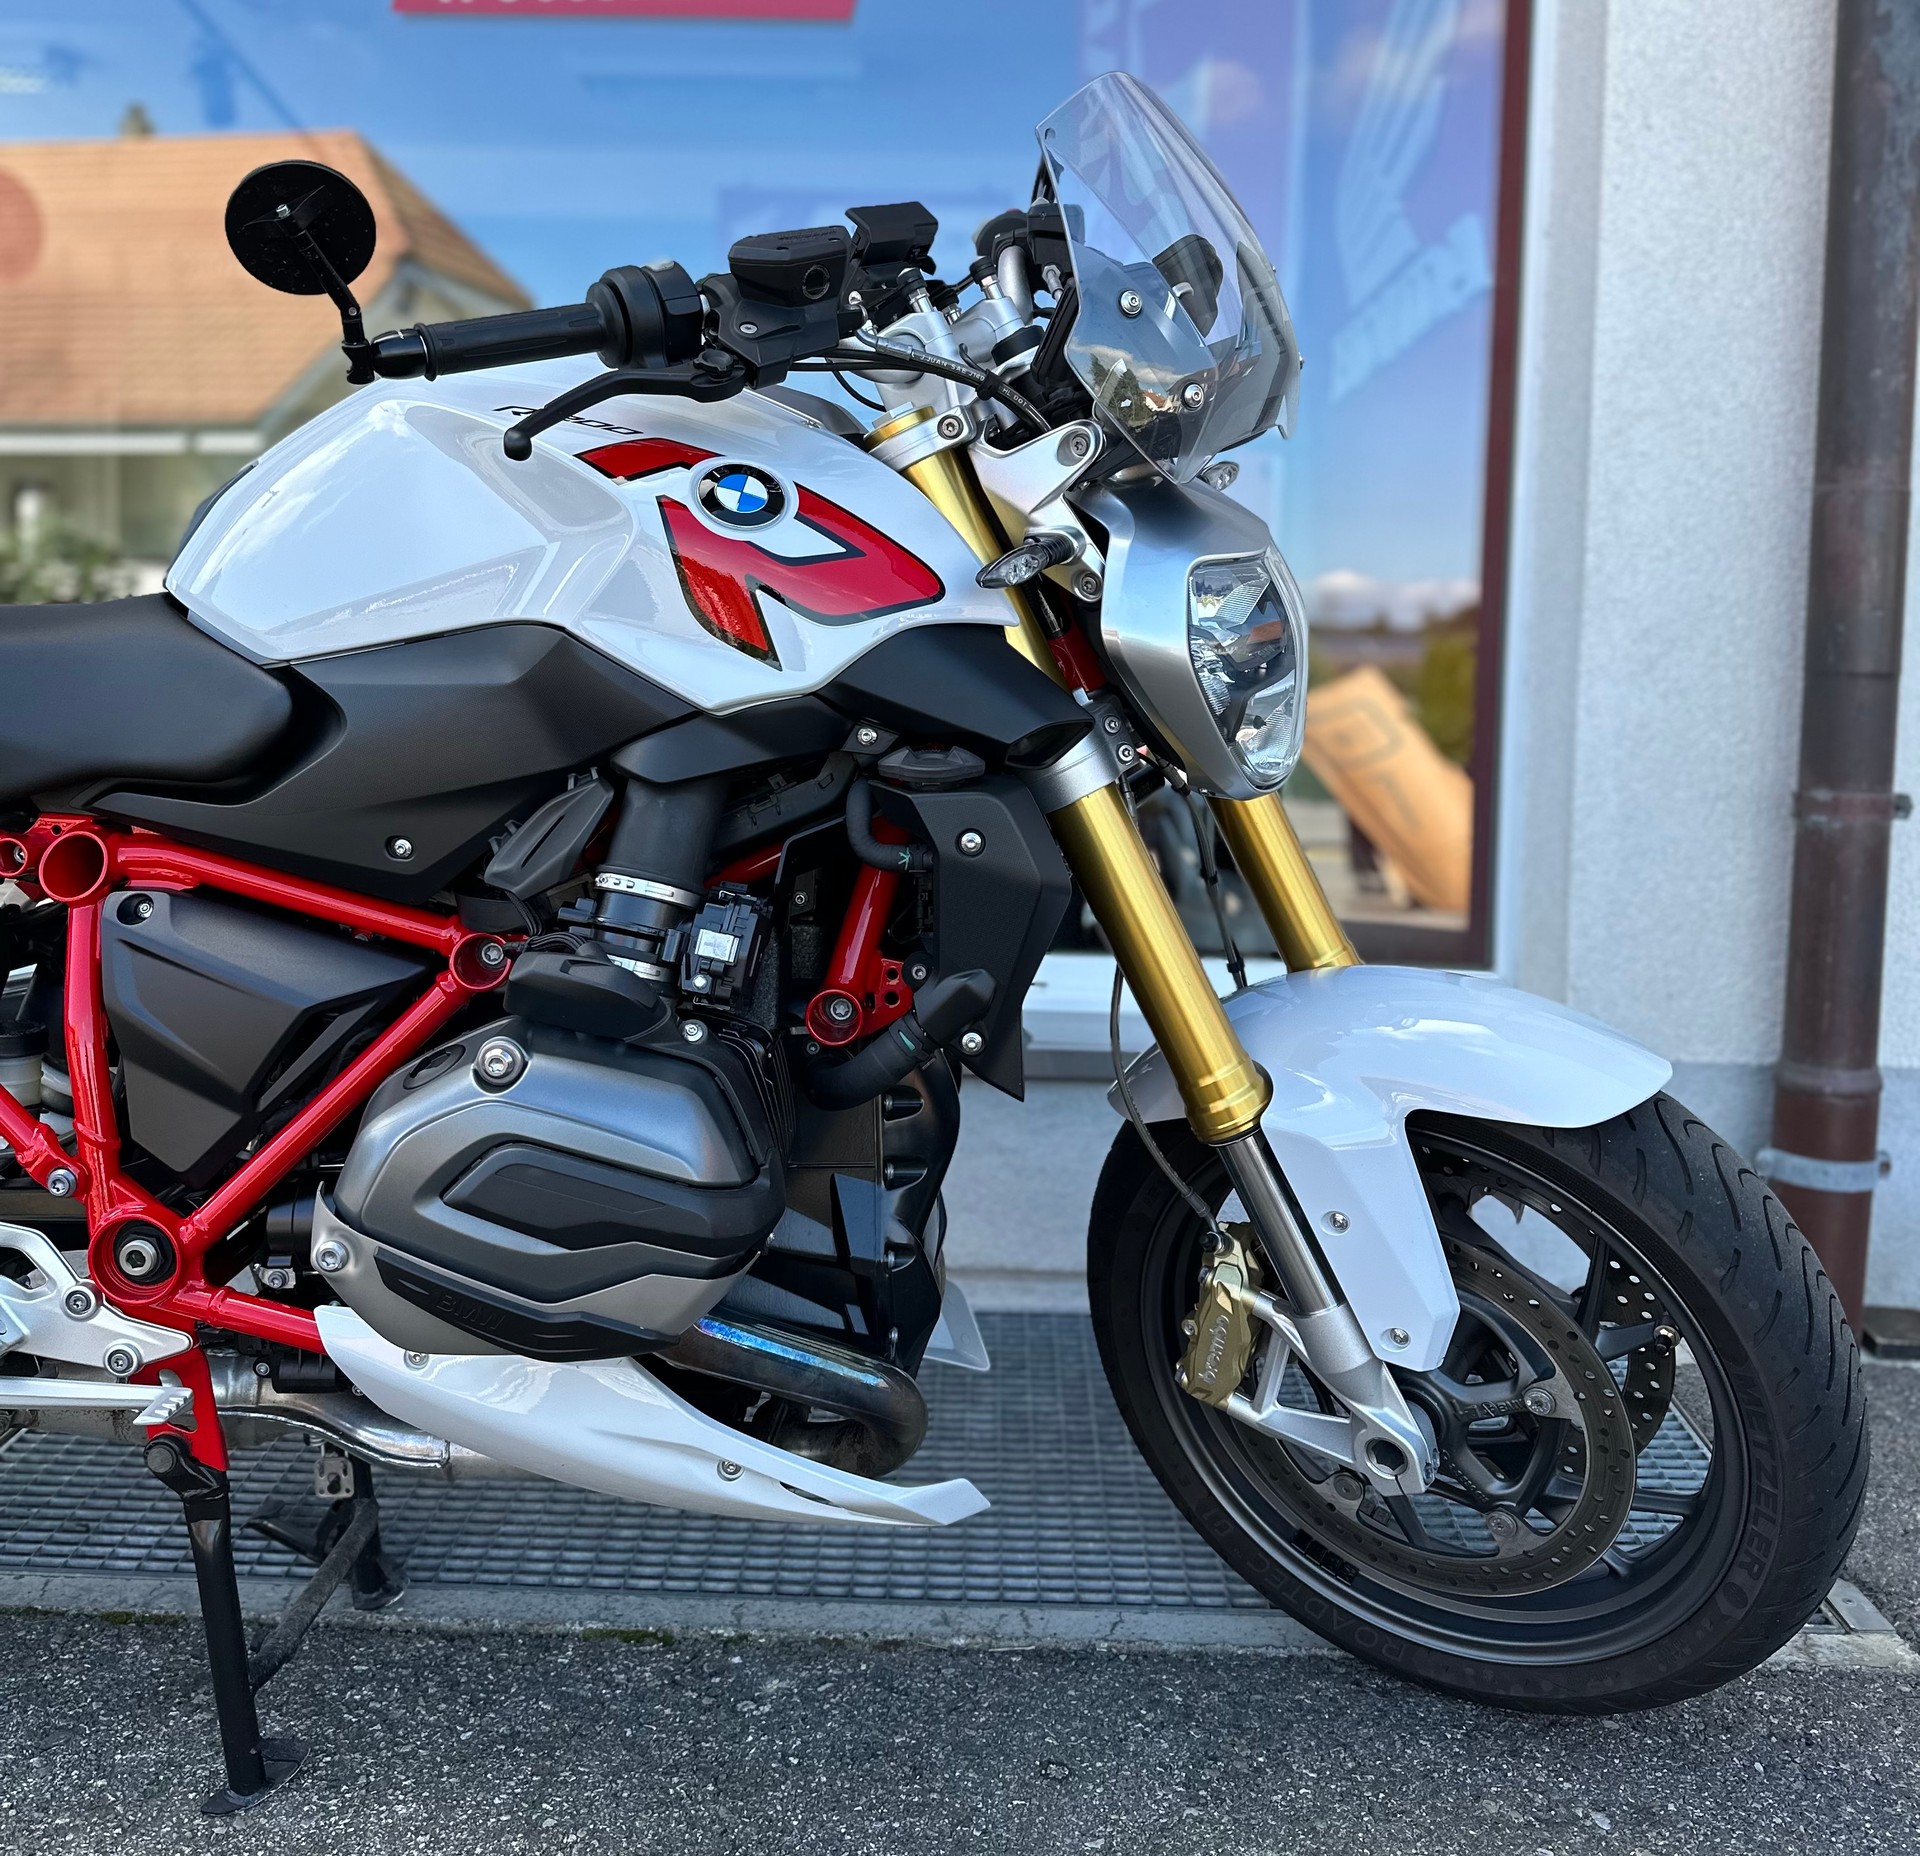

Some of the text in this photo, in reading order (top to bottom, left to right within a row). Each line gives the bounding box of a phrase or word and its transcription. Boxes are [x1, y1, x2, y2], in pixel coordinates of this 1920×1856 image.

[951, 363, 968, 374] SAE
[435, 1294, 506, 1330] BMW
[1197, 1314, 1230, 1384] brembo
[1732, 1371, 1778, 1581] METZELER
[1246, 1551, 1407, 1663] ROADTEC
